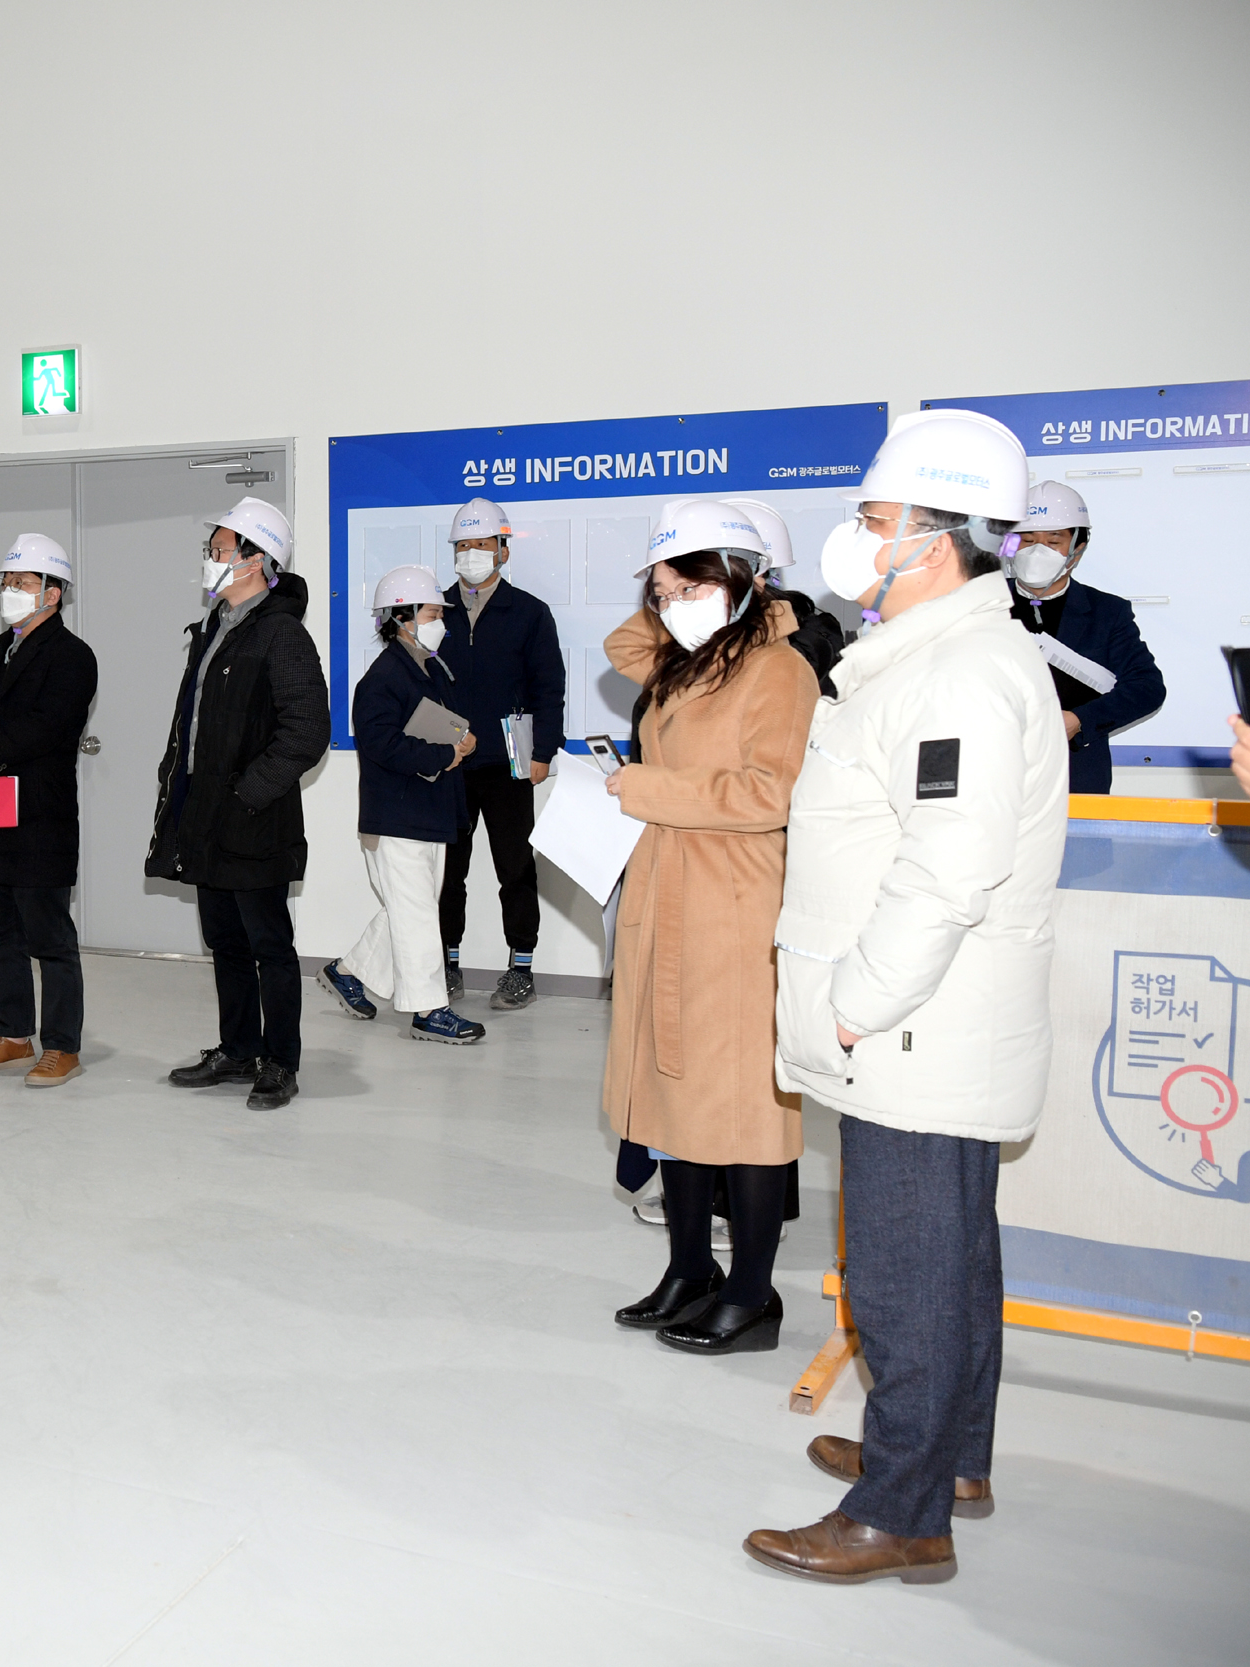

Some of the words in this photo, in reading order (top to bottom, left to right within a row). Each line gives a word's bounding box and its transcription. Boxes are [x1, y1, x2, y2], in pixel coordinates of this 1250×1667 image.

[1041, 420, 1092, 445] 상생
[1100, 413, 1249, 442] INFORMATI
[462, 458, 516, 487] 상생
[525, 447, 728, 483] INFORMATION
[798, 464, 861, 477] 광주글로벌모터스
[1130, 973, 1175, 997] 작업
[1130, 997, 1198, 1022] 허가서
